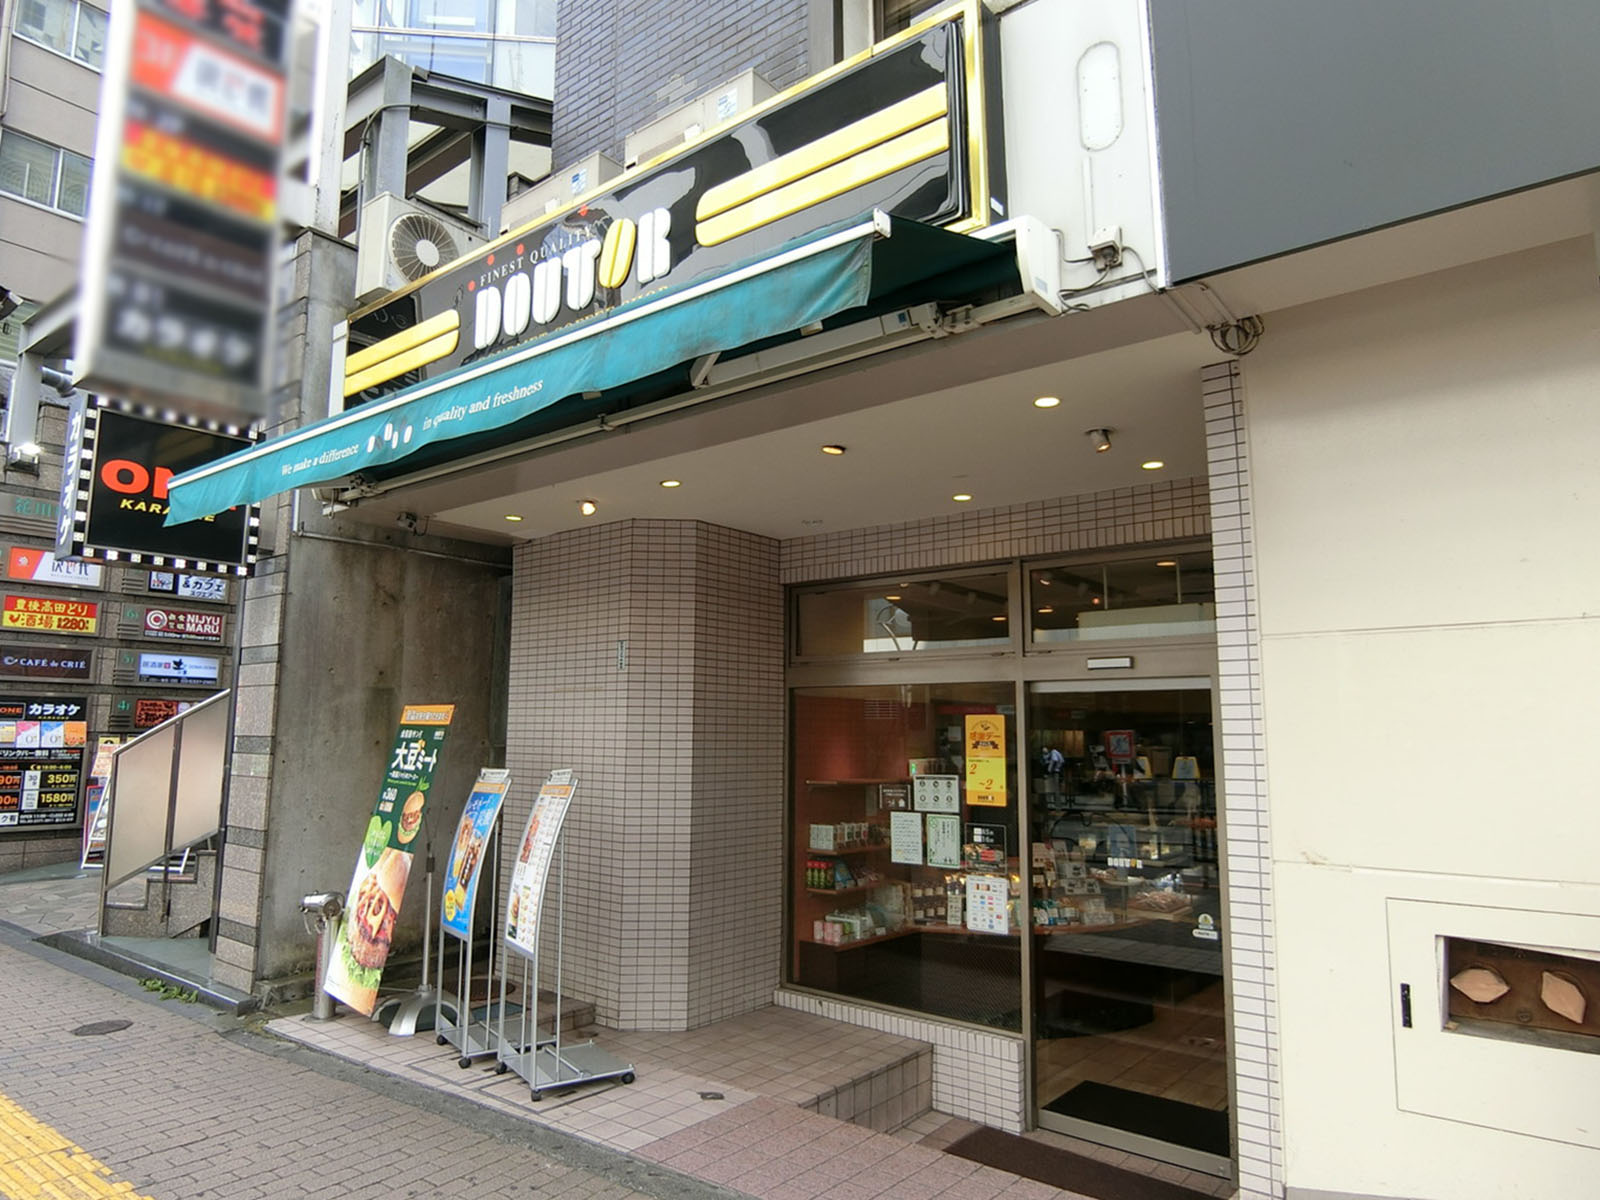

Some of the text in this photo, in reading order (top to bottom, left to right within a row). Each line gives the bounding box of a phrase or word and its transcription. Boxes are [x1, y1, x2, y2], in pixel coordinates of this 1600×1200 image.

[480, 225, 593, 287] FINEST QUALITY
[474, 207, 672, 350] DOUTOR
[422, 379, 544, 431] in quality and freshness
[319, 443, 360, 465] difference
[59, 410, 82, 546] カラオケ
[185, 613, 221, 626] NIJYU
[185, 622, 220, 634] MARU
[20, 657, 48, 667] CAFÉ
[28, 703, 81, 716] カラオケ
[391, 741, 438, 773] 大豆ミート
